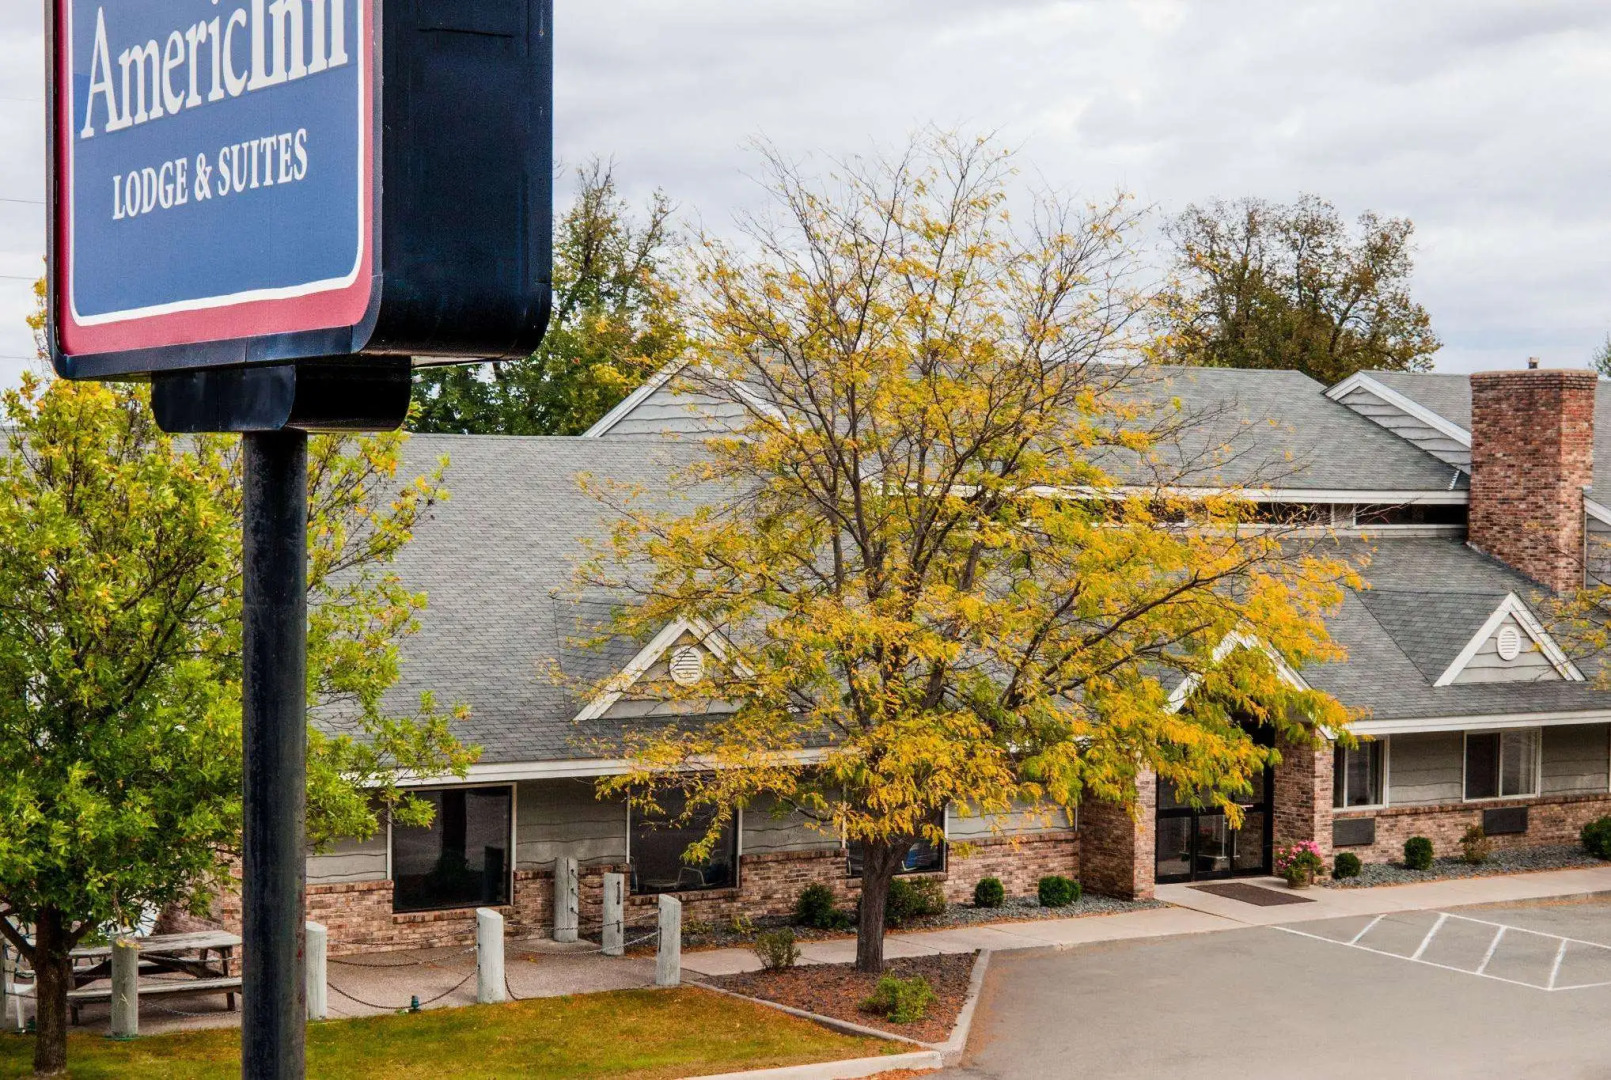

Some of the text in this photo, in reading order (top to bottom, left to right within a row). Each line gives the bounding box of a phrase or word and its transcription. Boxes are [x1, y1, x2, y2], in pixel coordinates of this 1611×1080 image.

[80, 0, 348, 139] AmericInn
[112, 128, 308, 220] LODGE & SUITES
